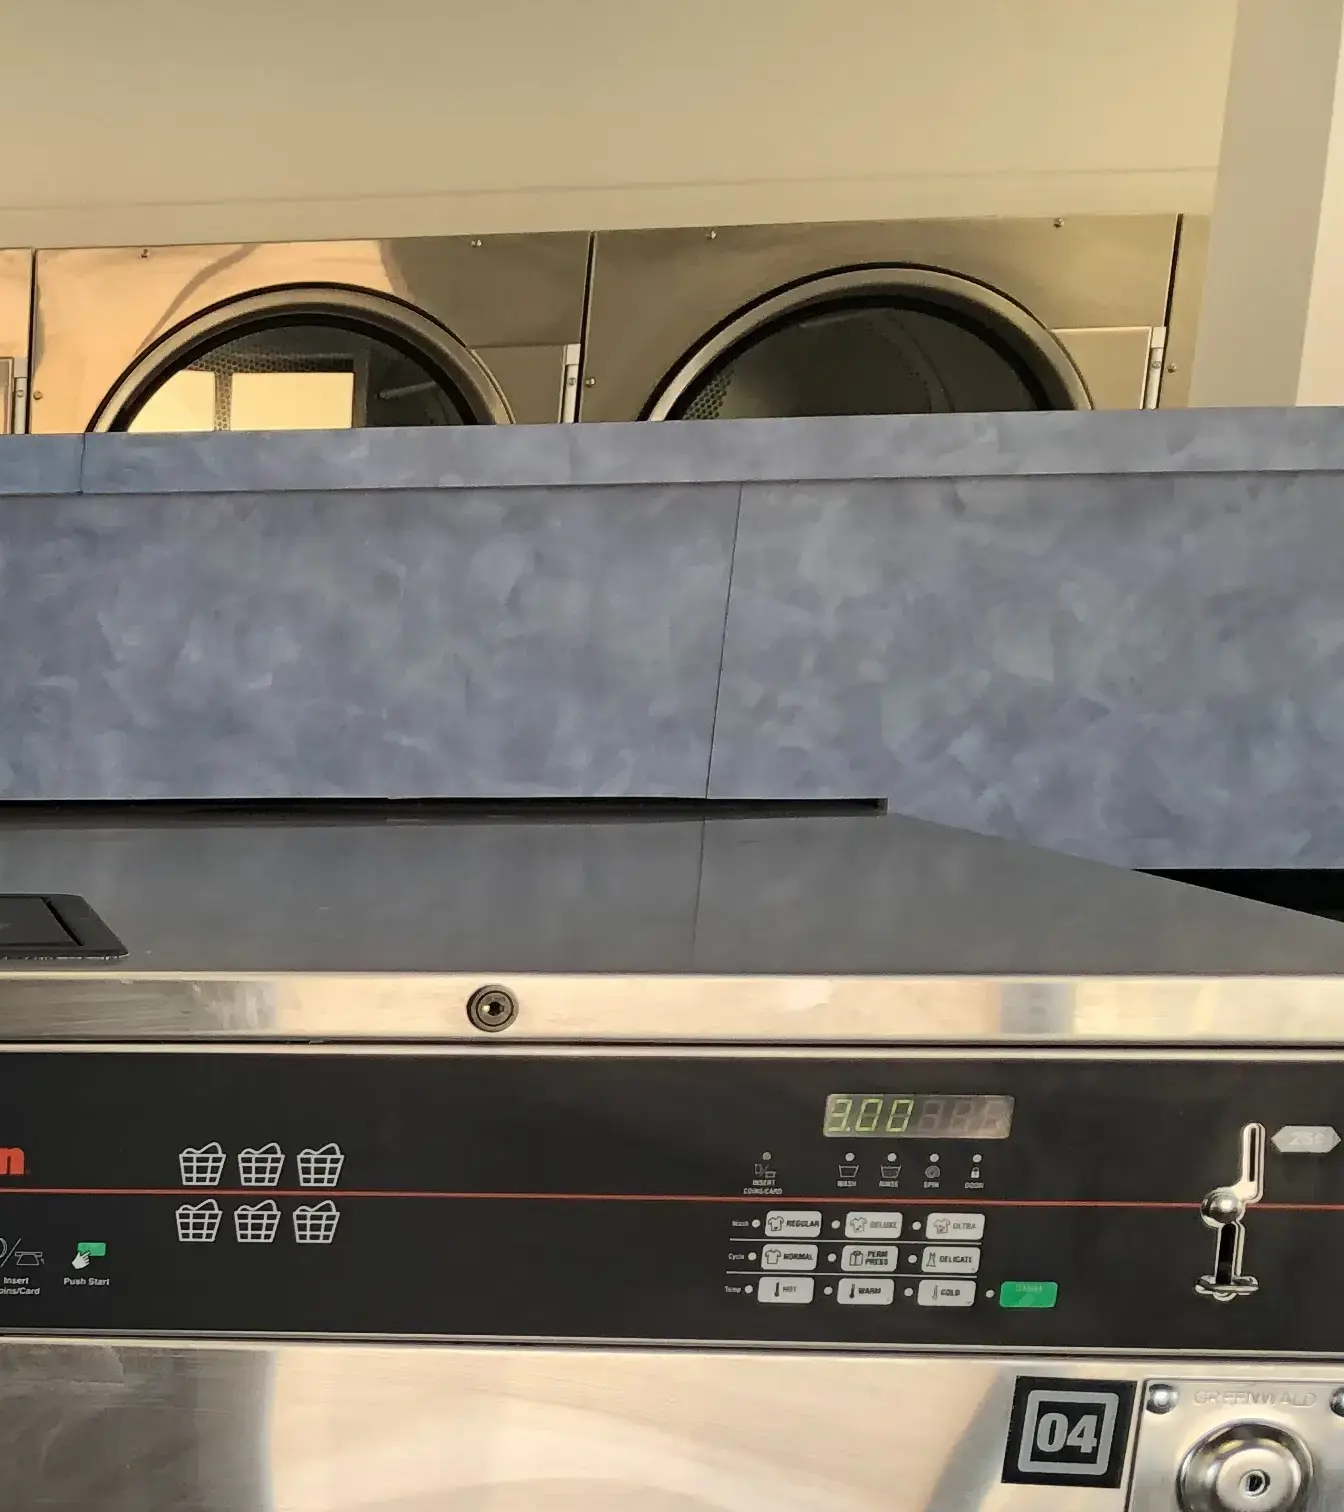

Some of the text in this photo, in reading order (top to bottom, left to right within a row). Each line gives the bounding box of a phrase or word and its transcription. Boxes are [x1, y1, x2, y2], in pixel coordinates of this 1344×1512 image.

[3, 1277, 29, 1285] Insert
[63, 1277, 110, 1286] Push Start
[1194, 1390, 1317, 1407] GREENWALD
[1036, 1412, 1097, 1454] 04
